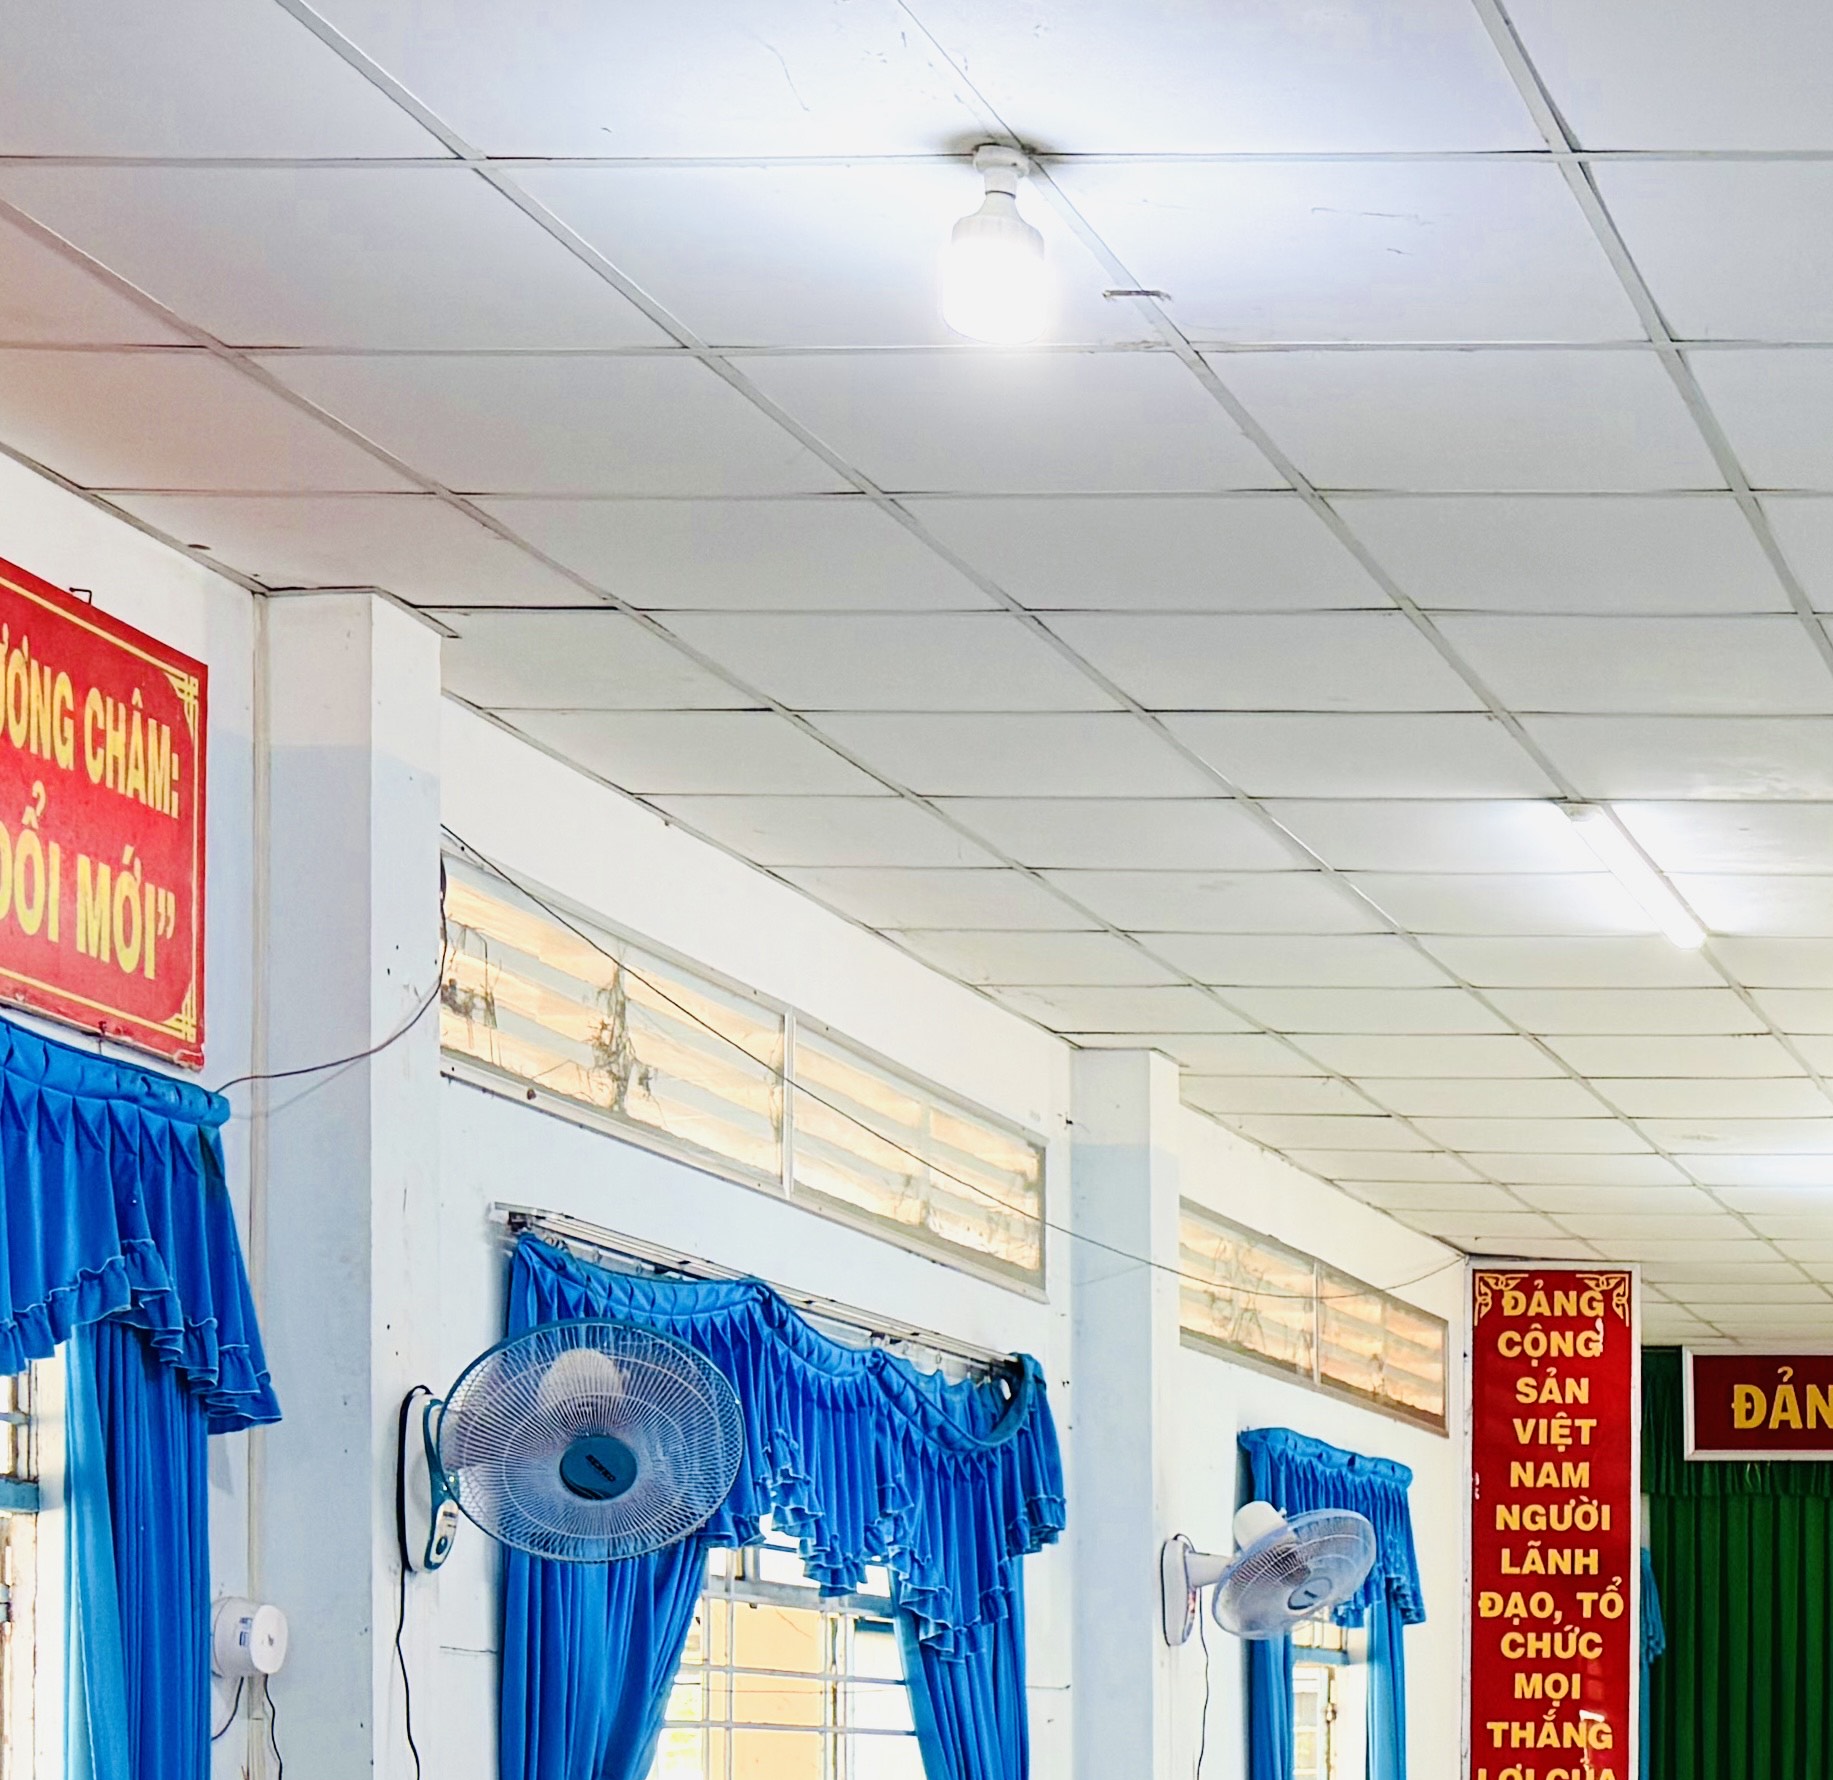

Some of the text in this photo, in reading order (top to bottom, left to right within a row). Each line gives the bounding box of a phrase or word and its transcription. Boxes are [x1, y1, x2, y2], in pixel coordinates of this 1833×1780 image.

[84, 687, 179, 819] CHÂM:
[1502, 1279, 1605, 1317] ĐẢNG
[1497, 1323, 1604, 1367] CỘNG
[1515, 1367, 1590, 1404] SẢN
[1512, 1412, 1597, 1452] VIỆT
[1510, 1461, 1590, 1488] NAM
[1495, 1496, 1611, 1531] NGƯỜI
[1501, 1540, 1599, 1575] LÃNH
[1478, 1576, 1625, 1626] ĐẠO, TỔ
[1500, 1624, 1603, 1660] CHỨC
[1514, 1672, 1581, 1707] MỌI
[1486, 1710, 1614, 1749] THẮNG
